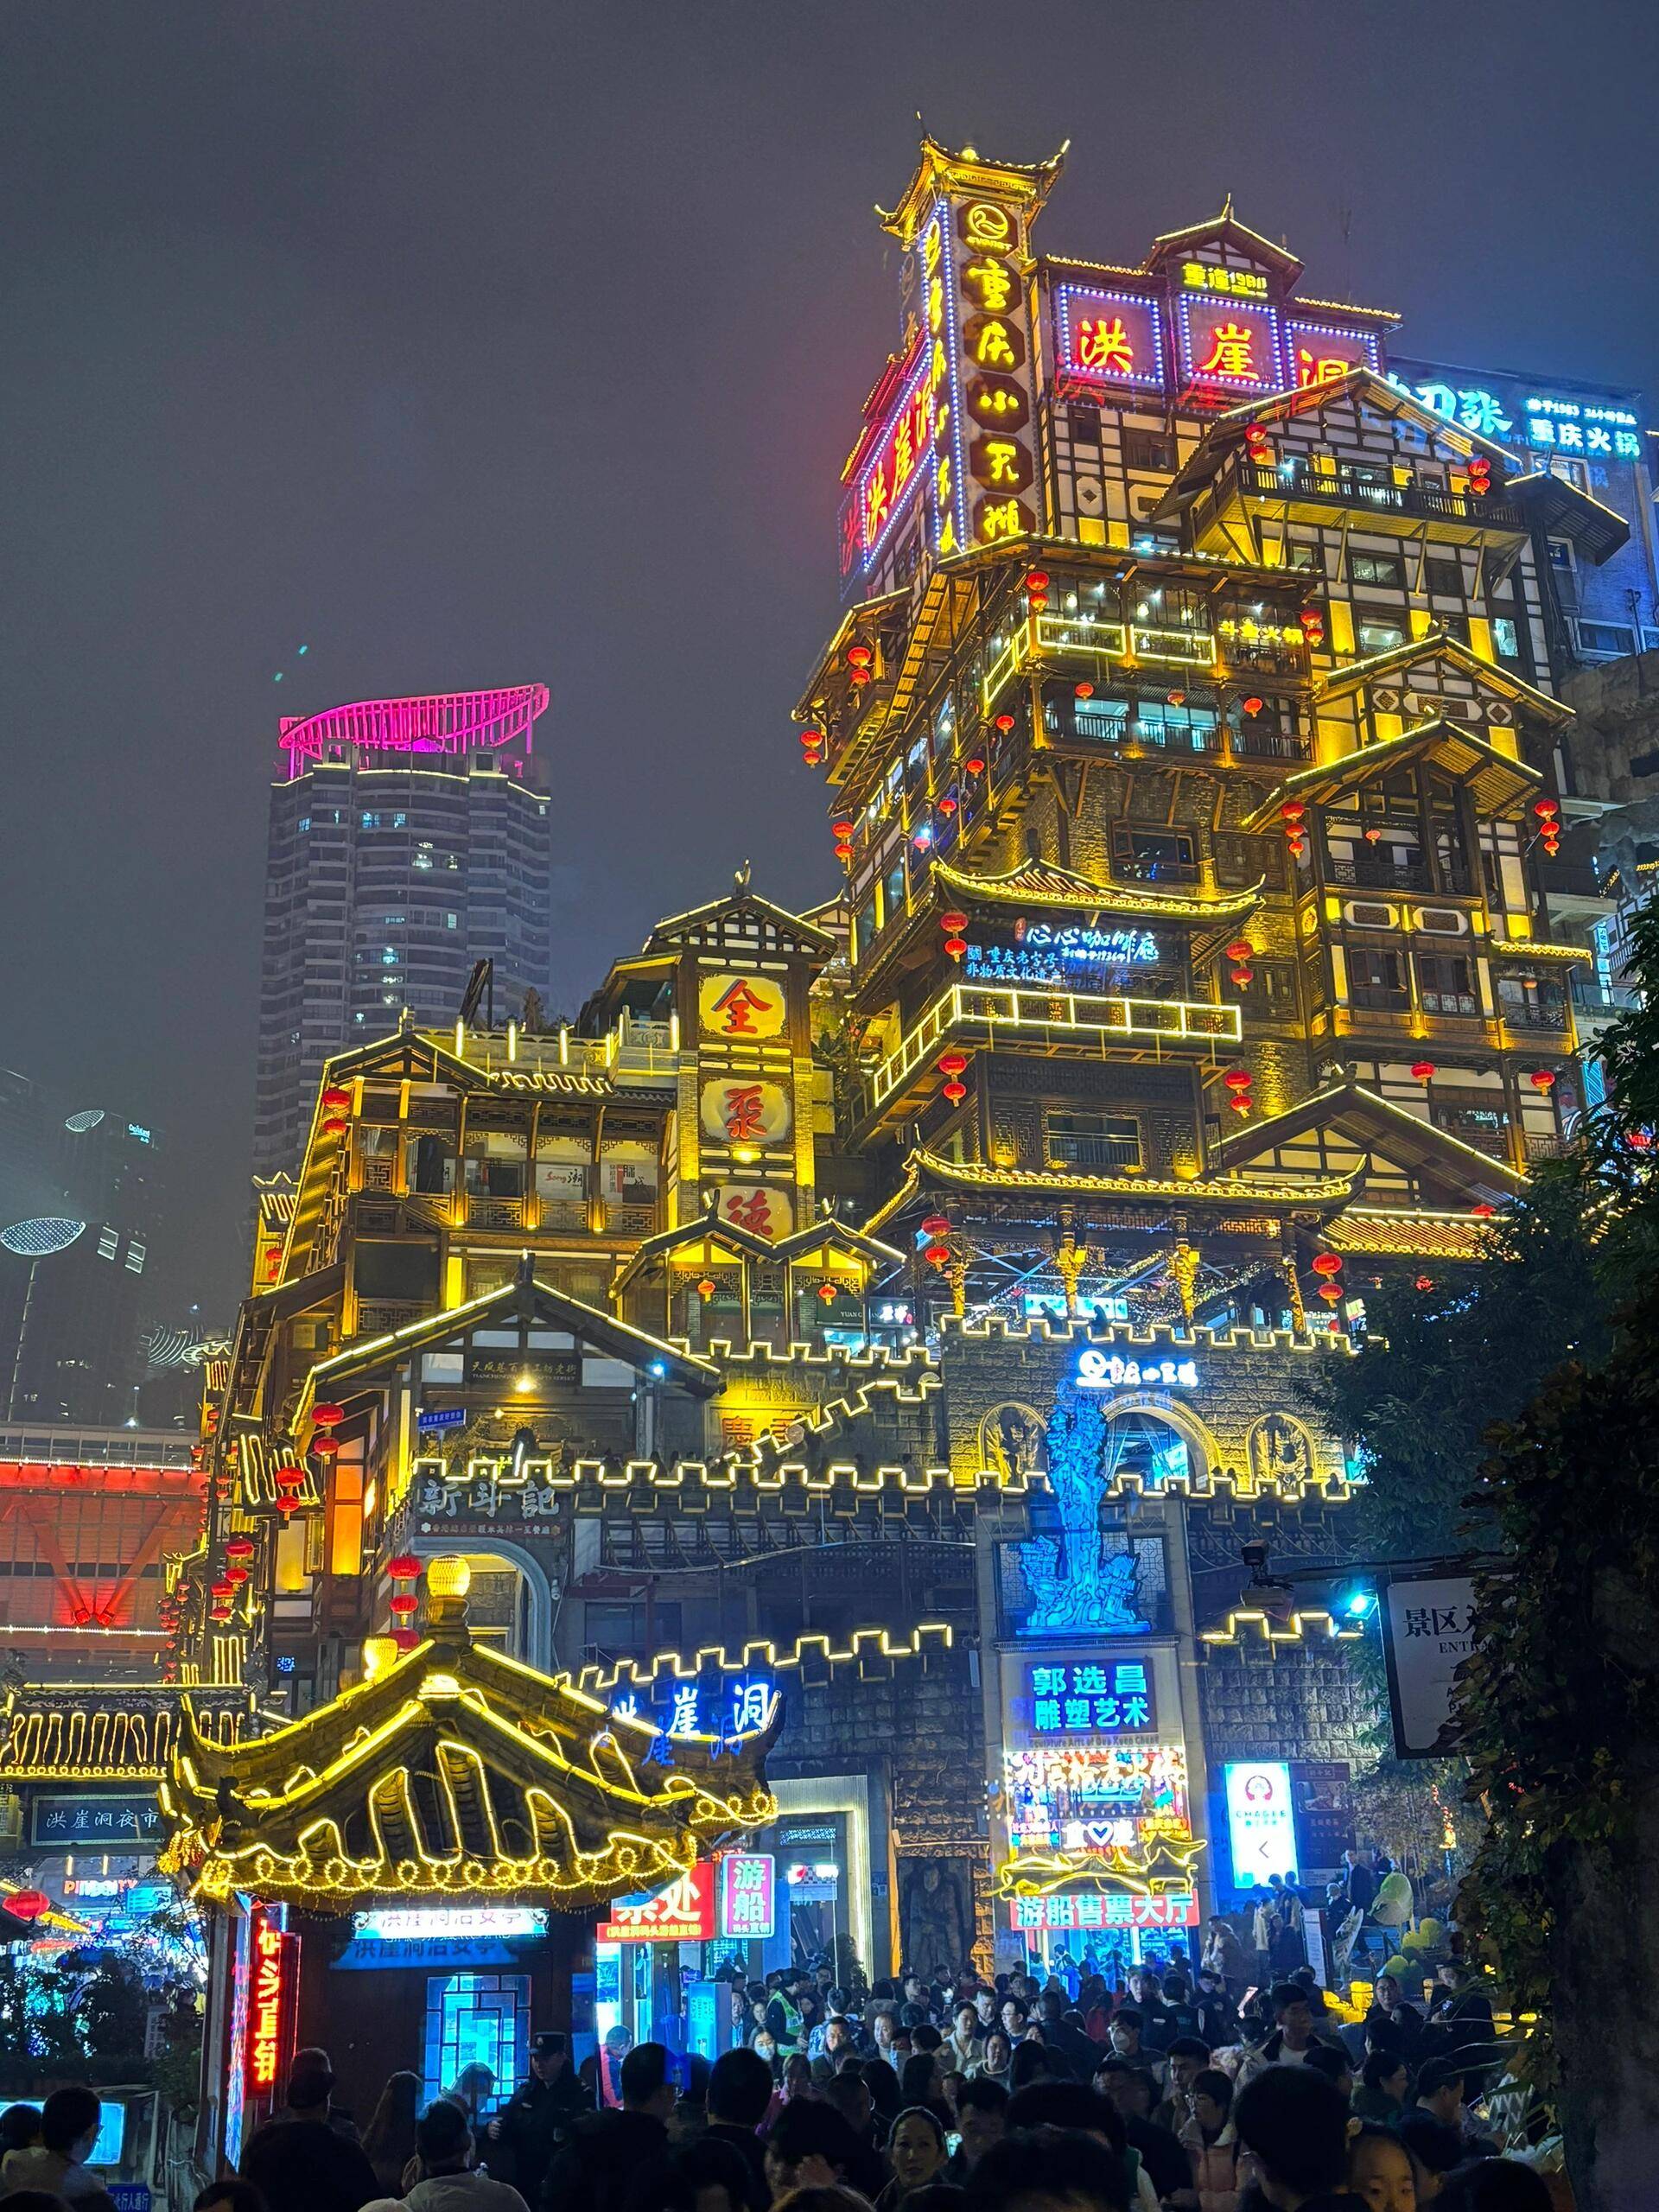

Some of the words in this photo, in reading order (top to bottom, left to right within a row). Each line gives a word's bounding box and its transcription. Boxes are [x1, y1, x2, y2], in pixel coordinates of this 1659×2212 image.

[1529, 418, 1640, 457] 重庆火锅
[418, 1478, 560, 1519] 新斗記
[1033, 1664, 1147, 1696] 郭选昌
[1034, 1697, 1150, 1731] 雕塑艺术
[46, 1808, 159, 1829] 洪崖洞夜市
[733, 1859, 766, 1922] 游船
[1016, 1893, 1193, 1927] 游船售票大厅
